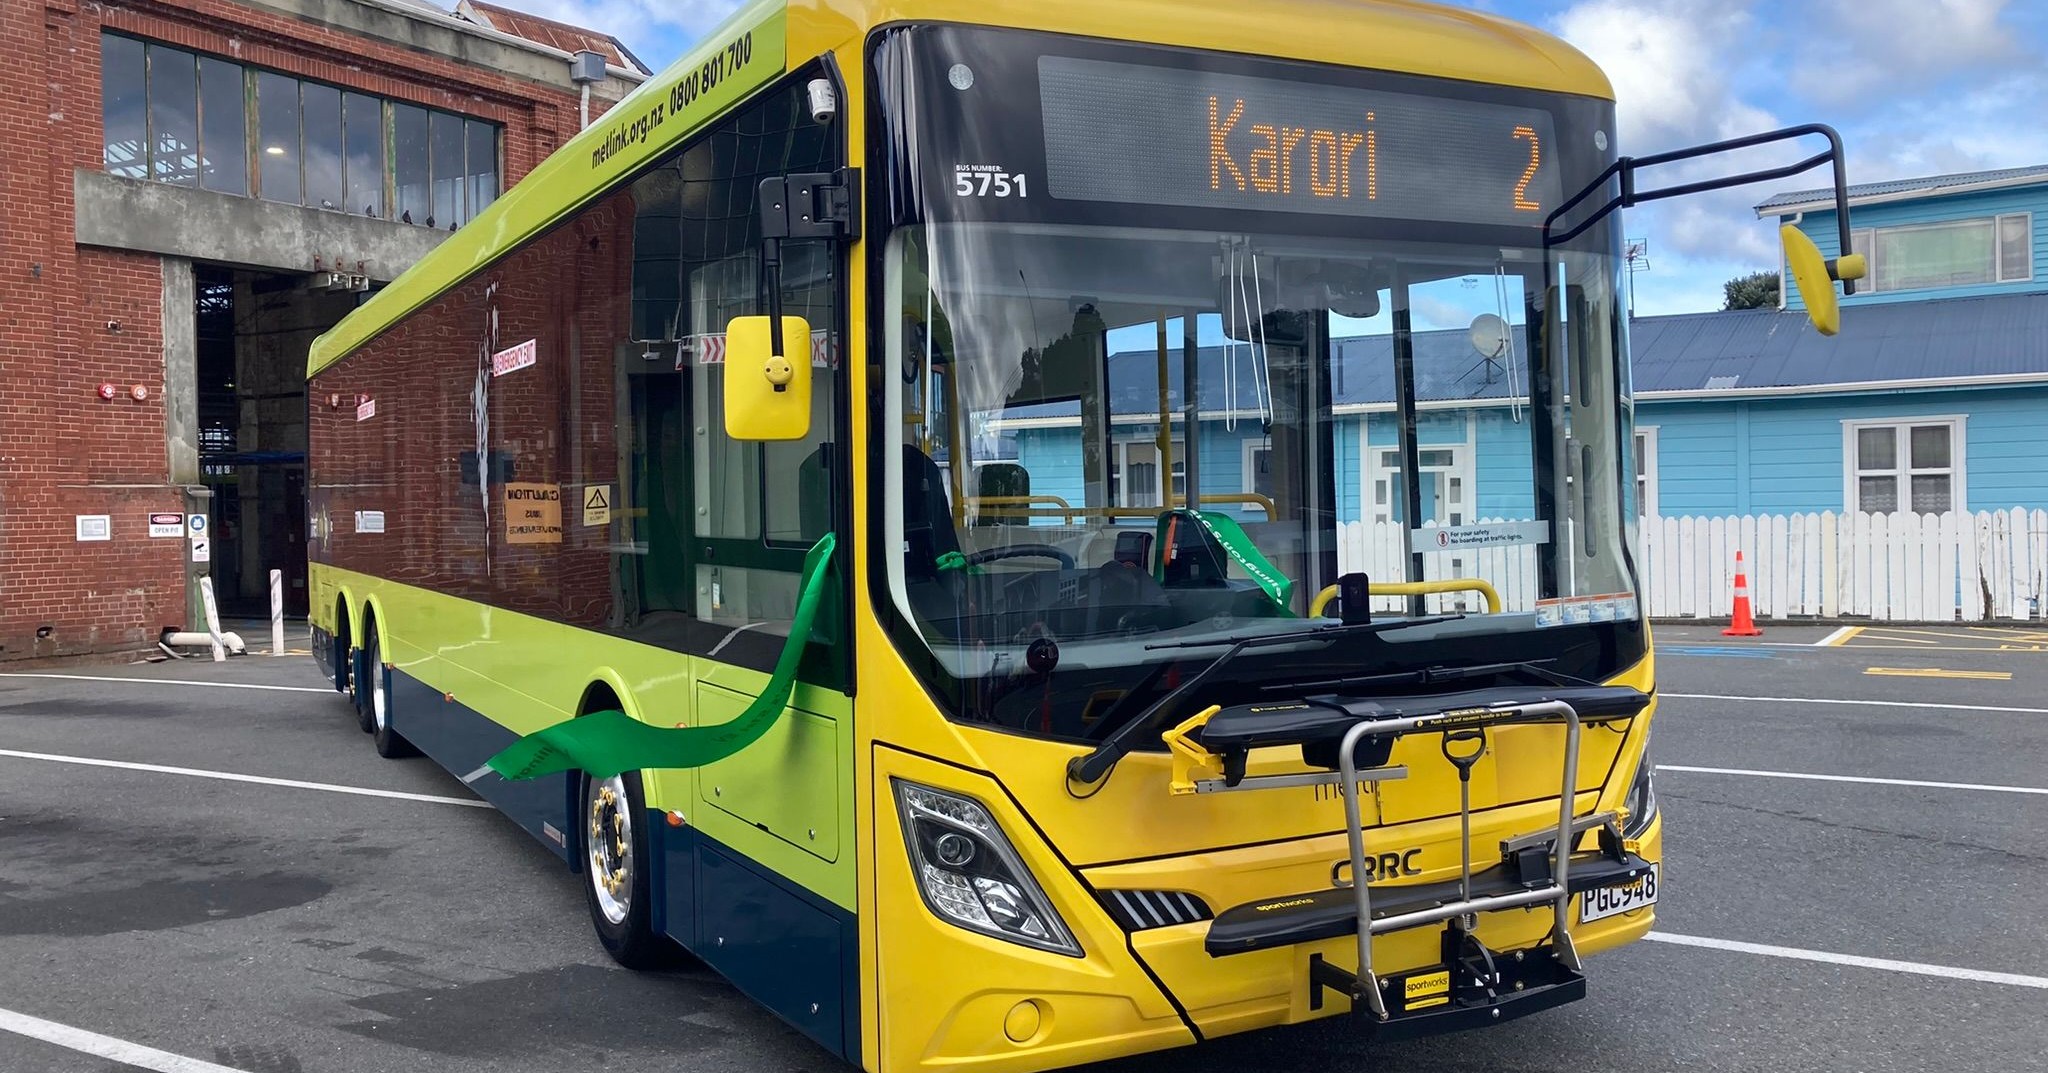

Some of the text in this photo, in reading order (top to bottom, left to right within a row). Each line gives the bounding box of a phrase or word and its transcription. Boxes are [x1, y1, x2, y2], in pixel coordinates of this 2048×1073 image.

[592, 30, 752, 169] metlink.org.nz 0800 801 700
[956, 172, 1027, 197] 5751
[1209, 95, 1540, 210] Karori 2
[1407, 977, 1448, 991] sportworks
